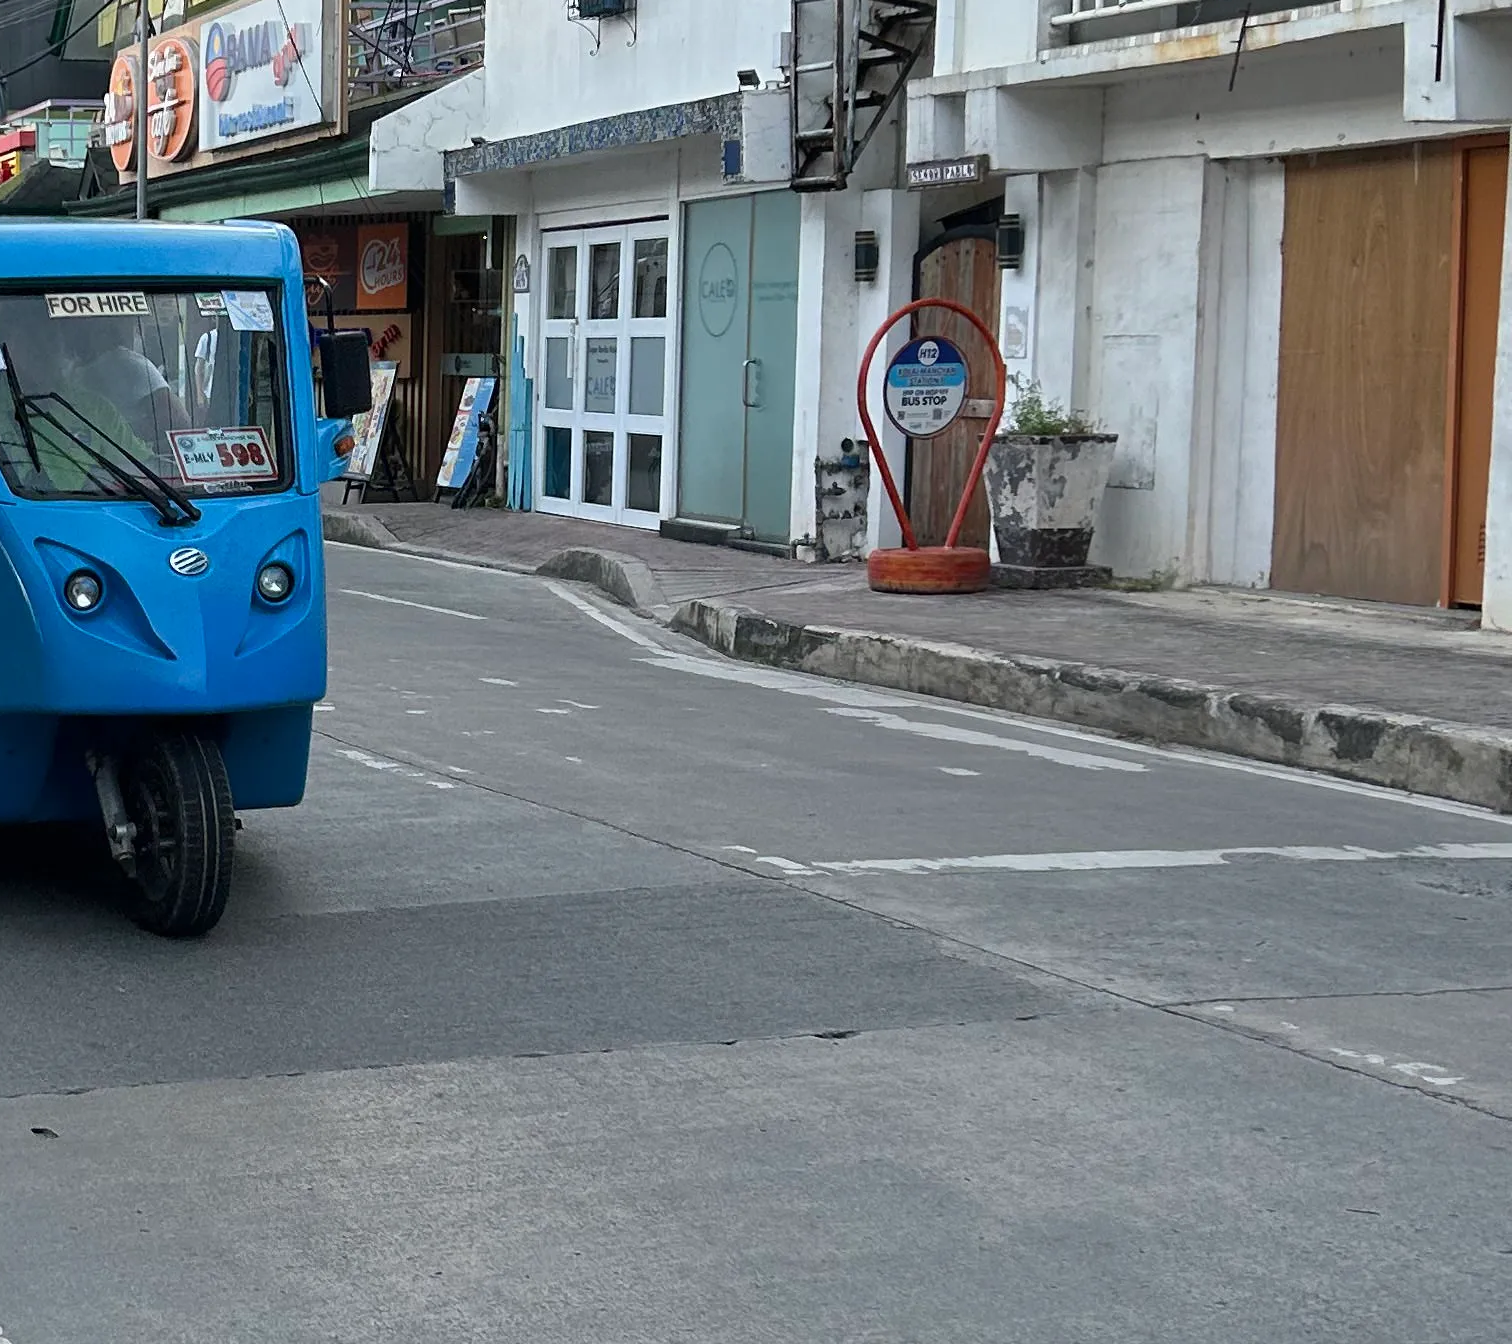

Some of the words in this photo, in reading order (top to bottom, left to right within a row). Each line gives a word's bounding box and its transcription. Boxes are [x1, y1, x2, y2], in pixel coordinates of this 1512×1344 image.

[376, 237, 400, 272] 24
[374, 268, 403, 288] HOURS
[47, 295, 95, 315] FOR
[97, 294, 148, 313] HIRE
[920, 349, 938, 359] H12
[902, 396, 921, 406] BUS
[922, 396, 947, 406] STOP
[215, 442, 265, 468] 598
